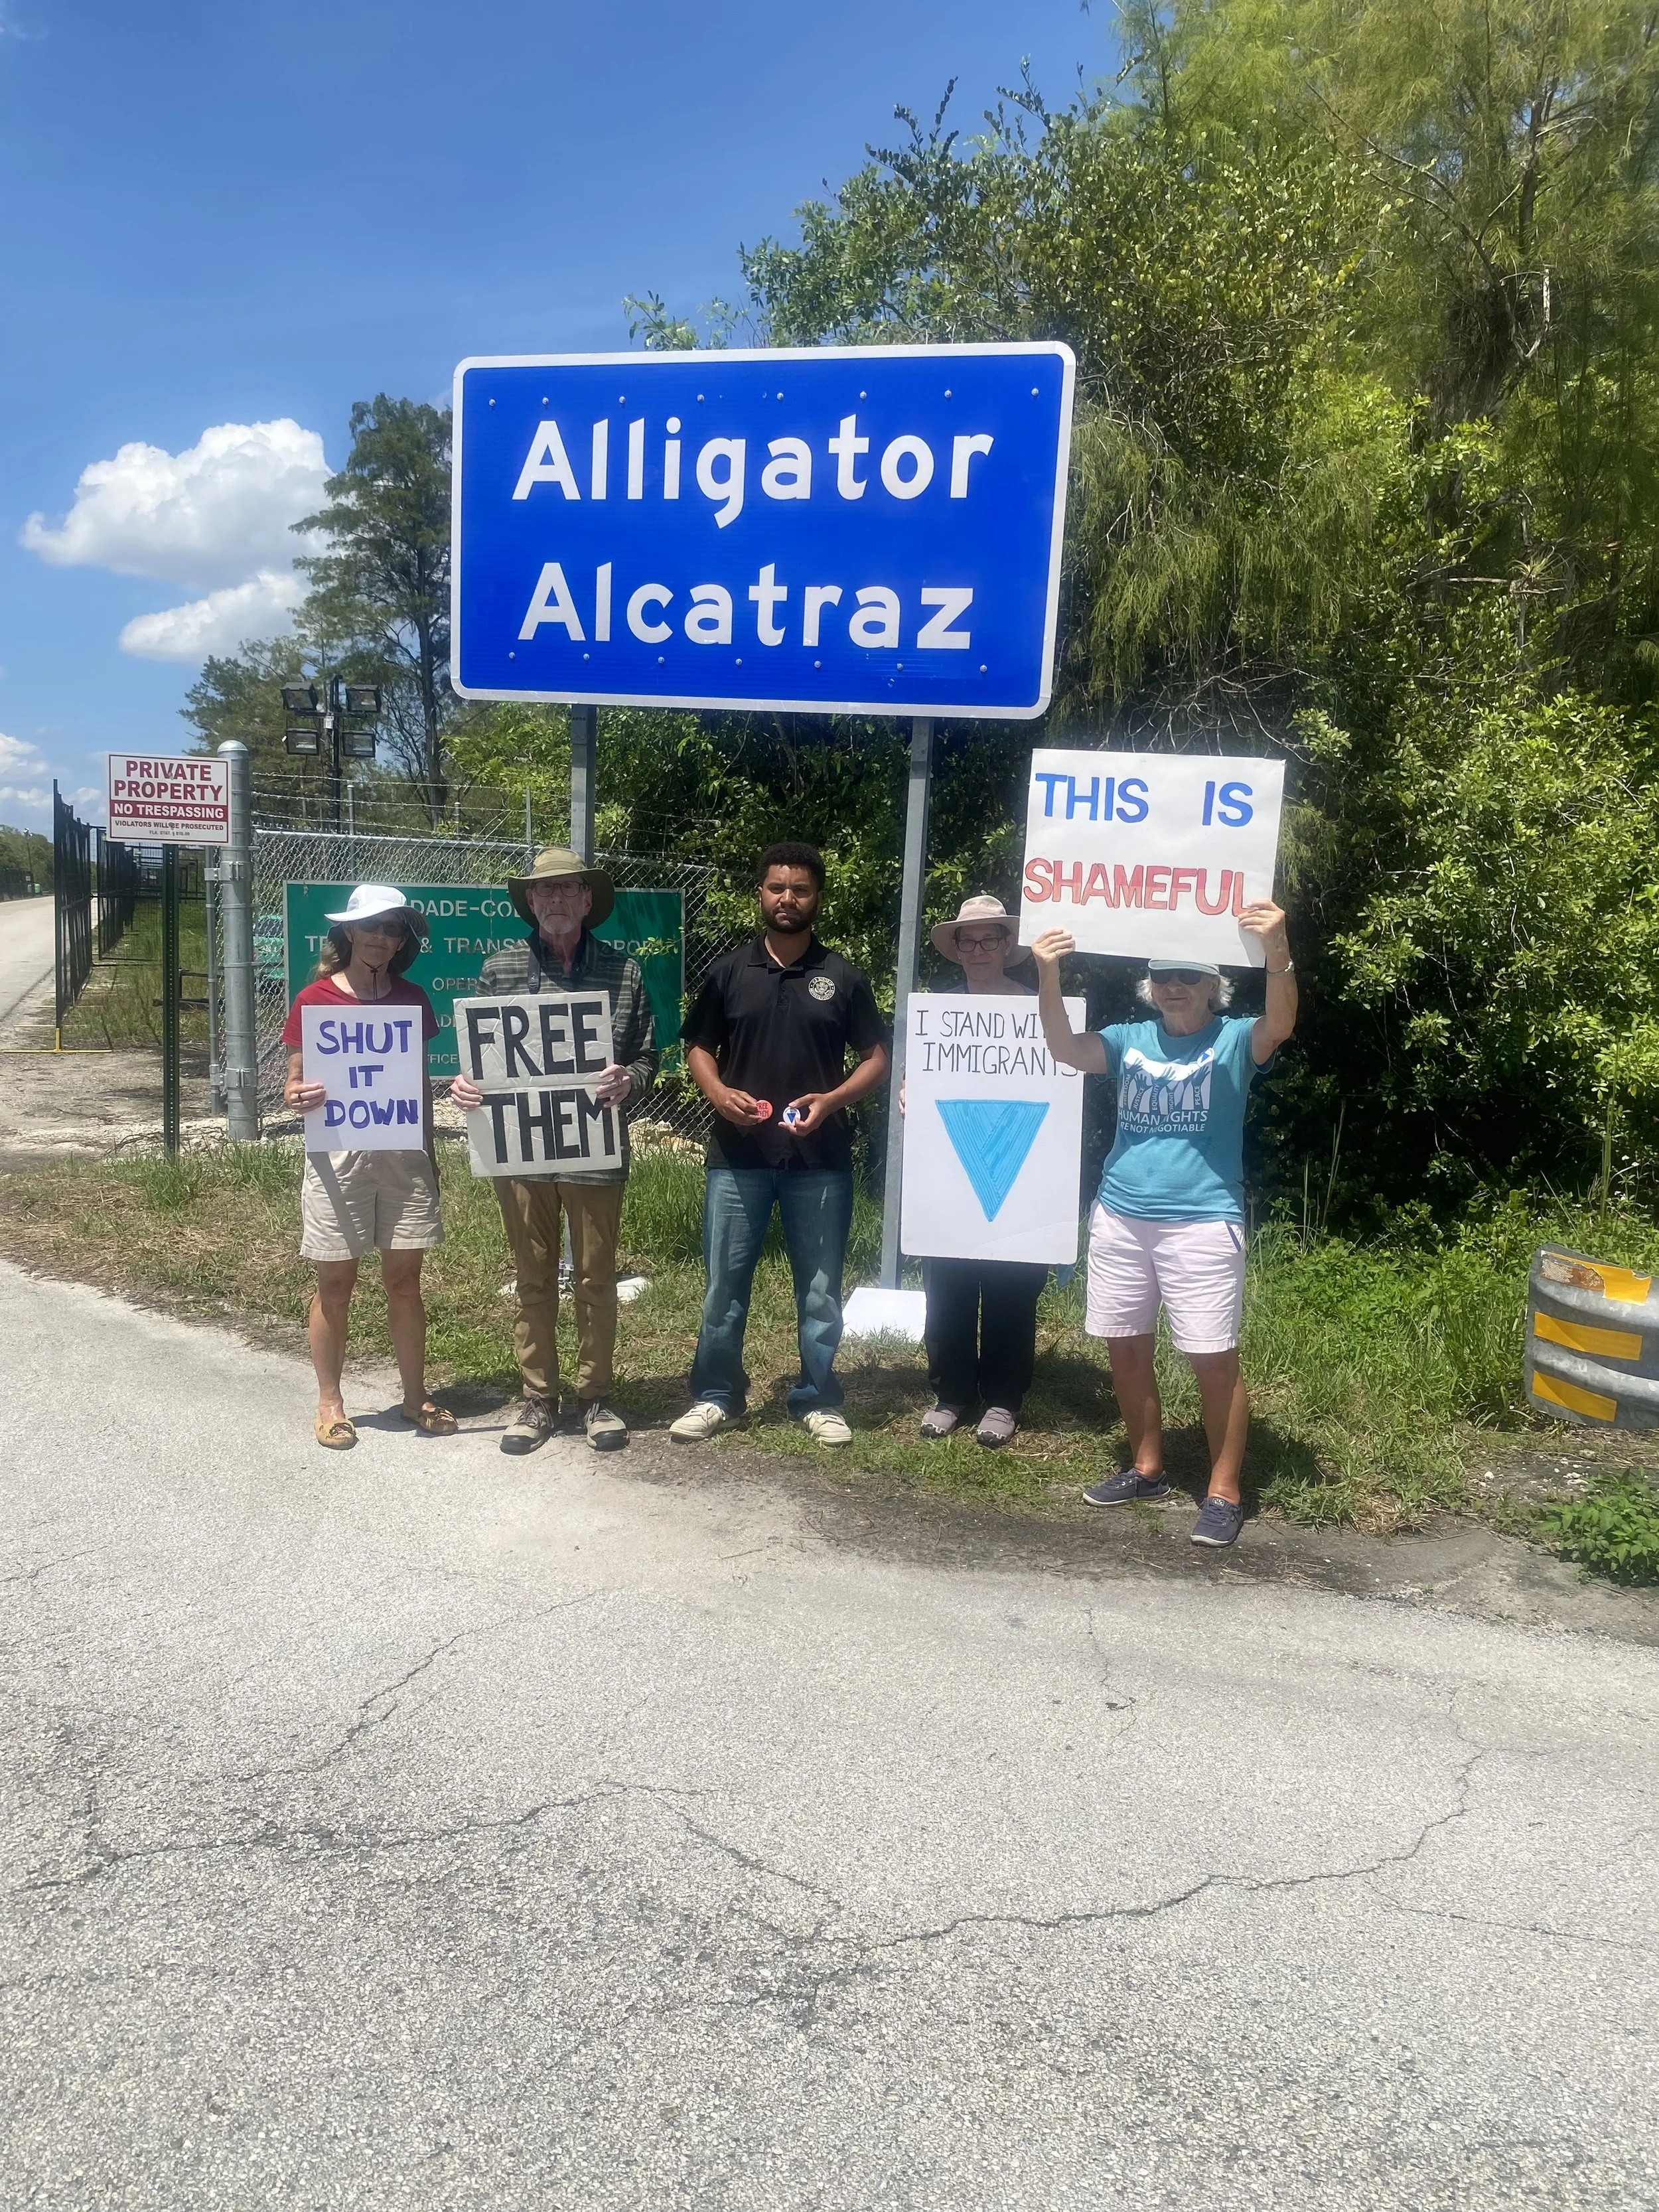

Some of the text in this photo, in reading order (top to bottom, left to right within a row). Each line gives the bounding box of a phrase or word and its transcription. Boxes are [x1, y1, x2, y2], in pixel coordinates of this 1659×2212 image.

[512, 413, 994, 530] Alligator
[517, 561, 974, 650] Alcatraz
[126, 760, 212, 781] PRIVATE
[114, 779, 223, 802] PROPERTY
[1035, 773, 1253, 828] THIS IS
[114, 803, 224, 819] NO TRESPASSING
[1023, 857, 1260, 917] SHAMEFUL
[410, 899, 521, 918] DADE-CO
[419, 937, 433, 954] &
[432, 977, 478, 991] OPER
[915, 1009, 1046, 1039] I STAND WI
[316, 1020, 413, 1055] SHUT
[465, 1001, 607, 1080] FREE
[348, 1065, 384, 1088] IT
[1133, 1086, 1145, 1110] JUSTICE
[324, 1098, 419, 1129] DOWN
[1118, 1110, 1161, 1126] HUMAN
[480, 1088, 616, 1164] THEM
[1130, 1125, 1149, 1134] NOT
